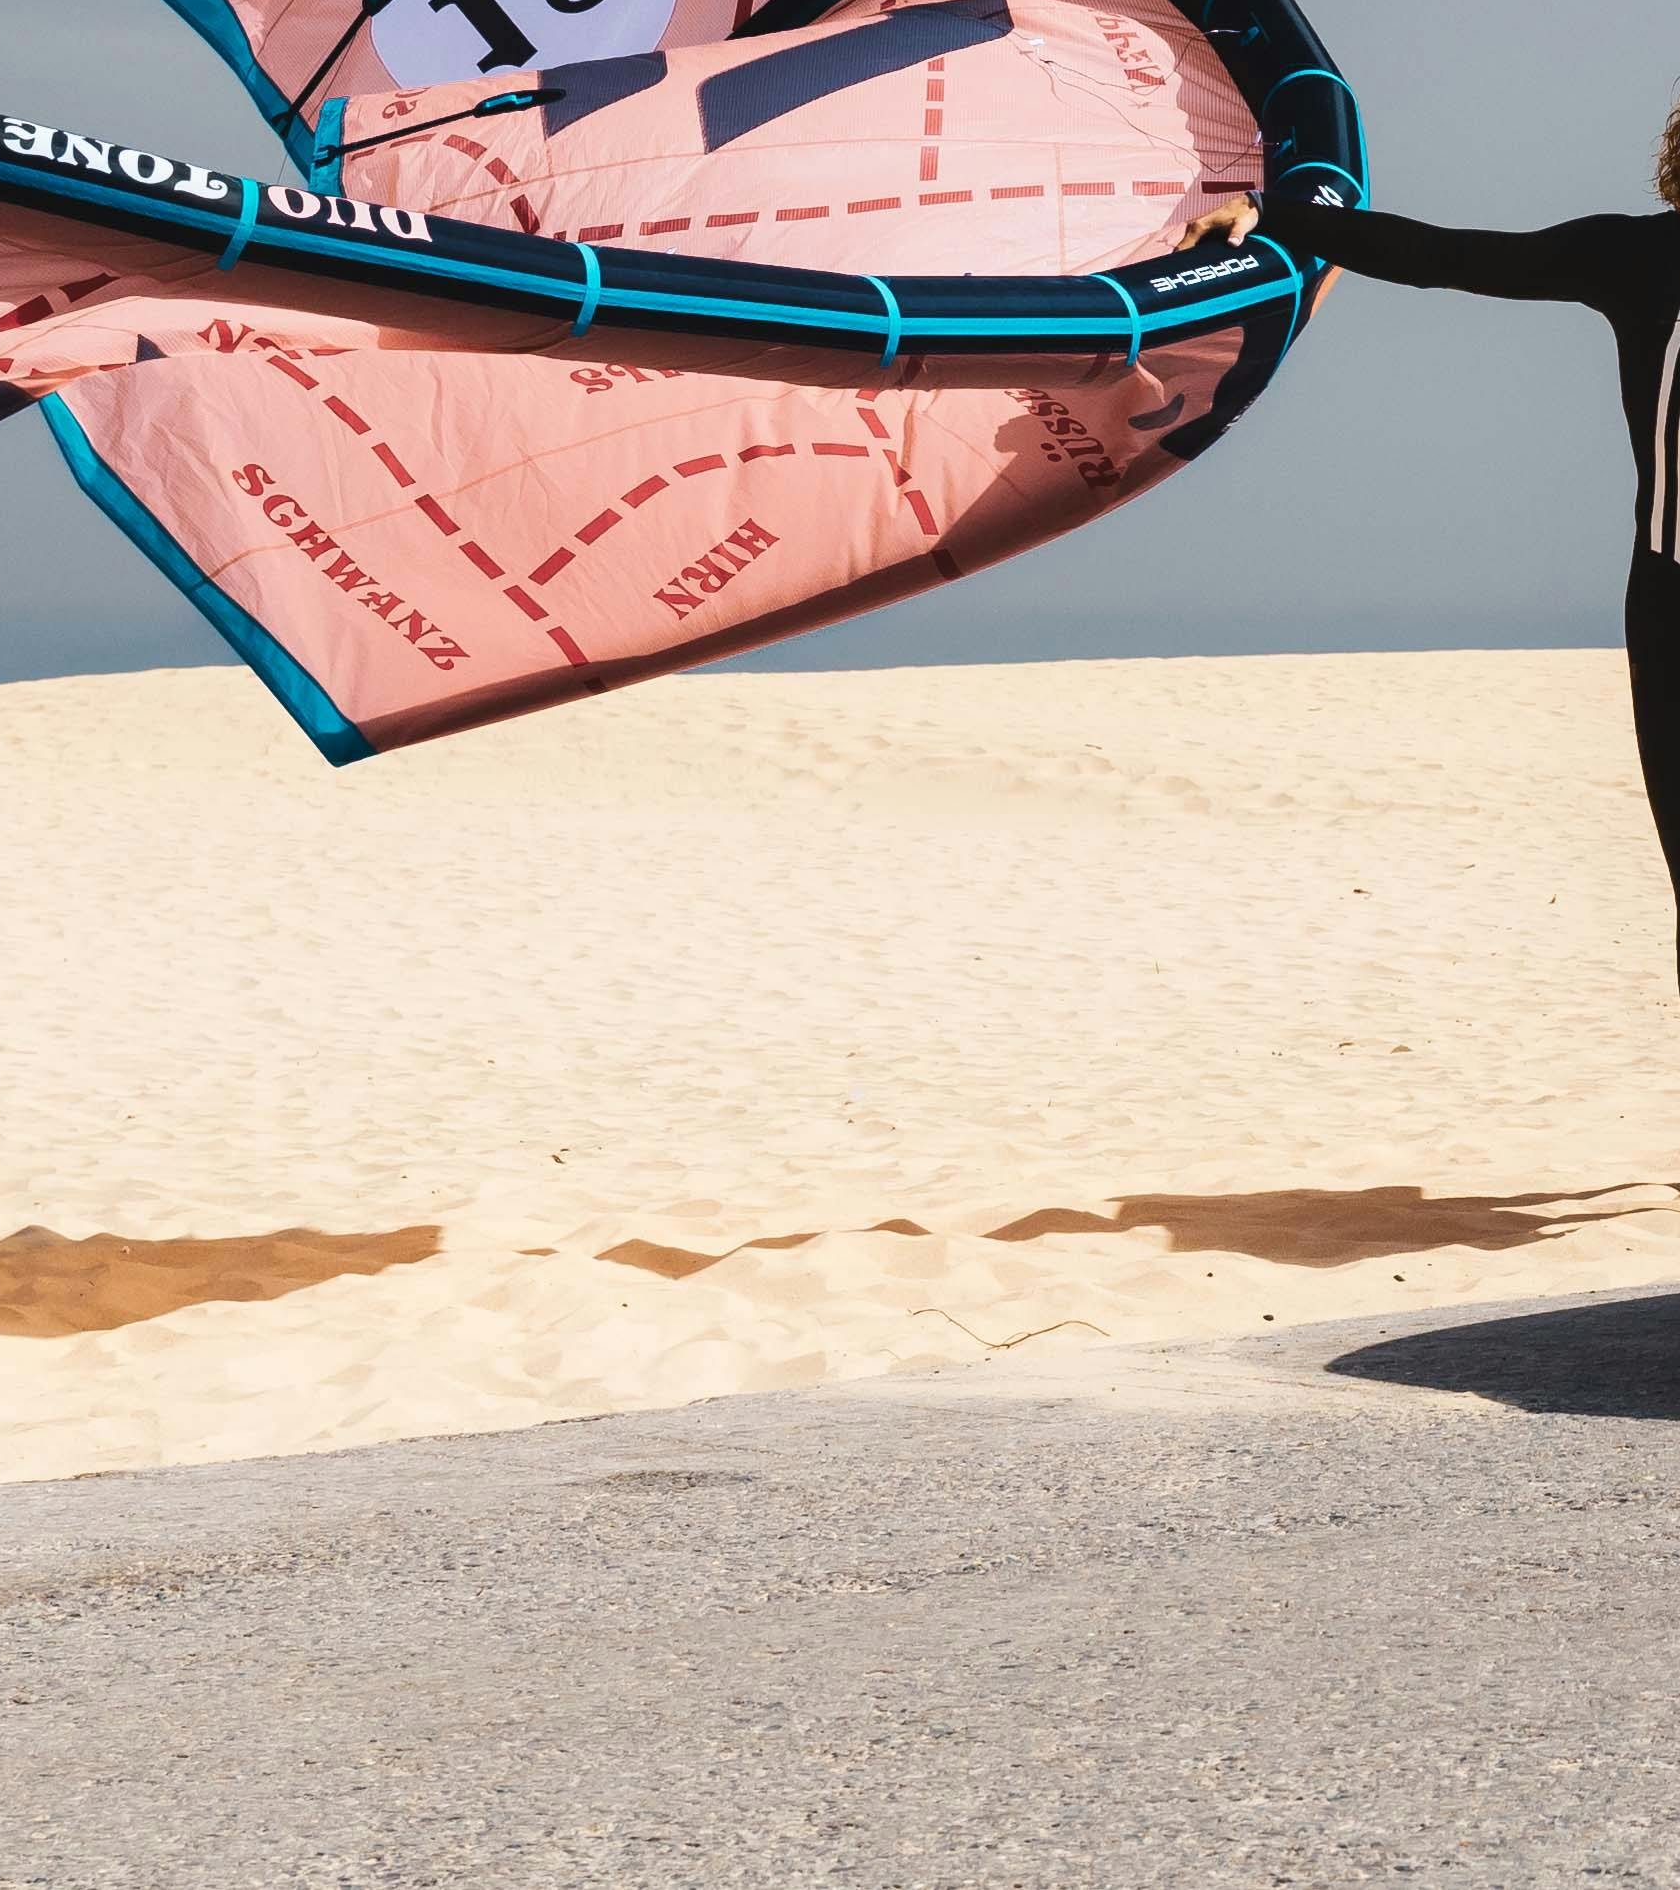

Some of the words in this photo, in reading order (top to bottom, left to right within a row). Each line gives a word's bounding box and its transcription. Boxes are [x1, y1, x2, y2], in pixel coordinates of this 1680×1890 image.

[1, 116, 229, 200] TONE
[266, 183, 433, 243] DUO
[1149, 252, 1260, 293] PORSCHE
[231, 461, 471, 672] SCHWANZ
[652, 517, 781, 620] HIRN
